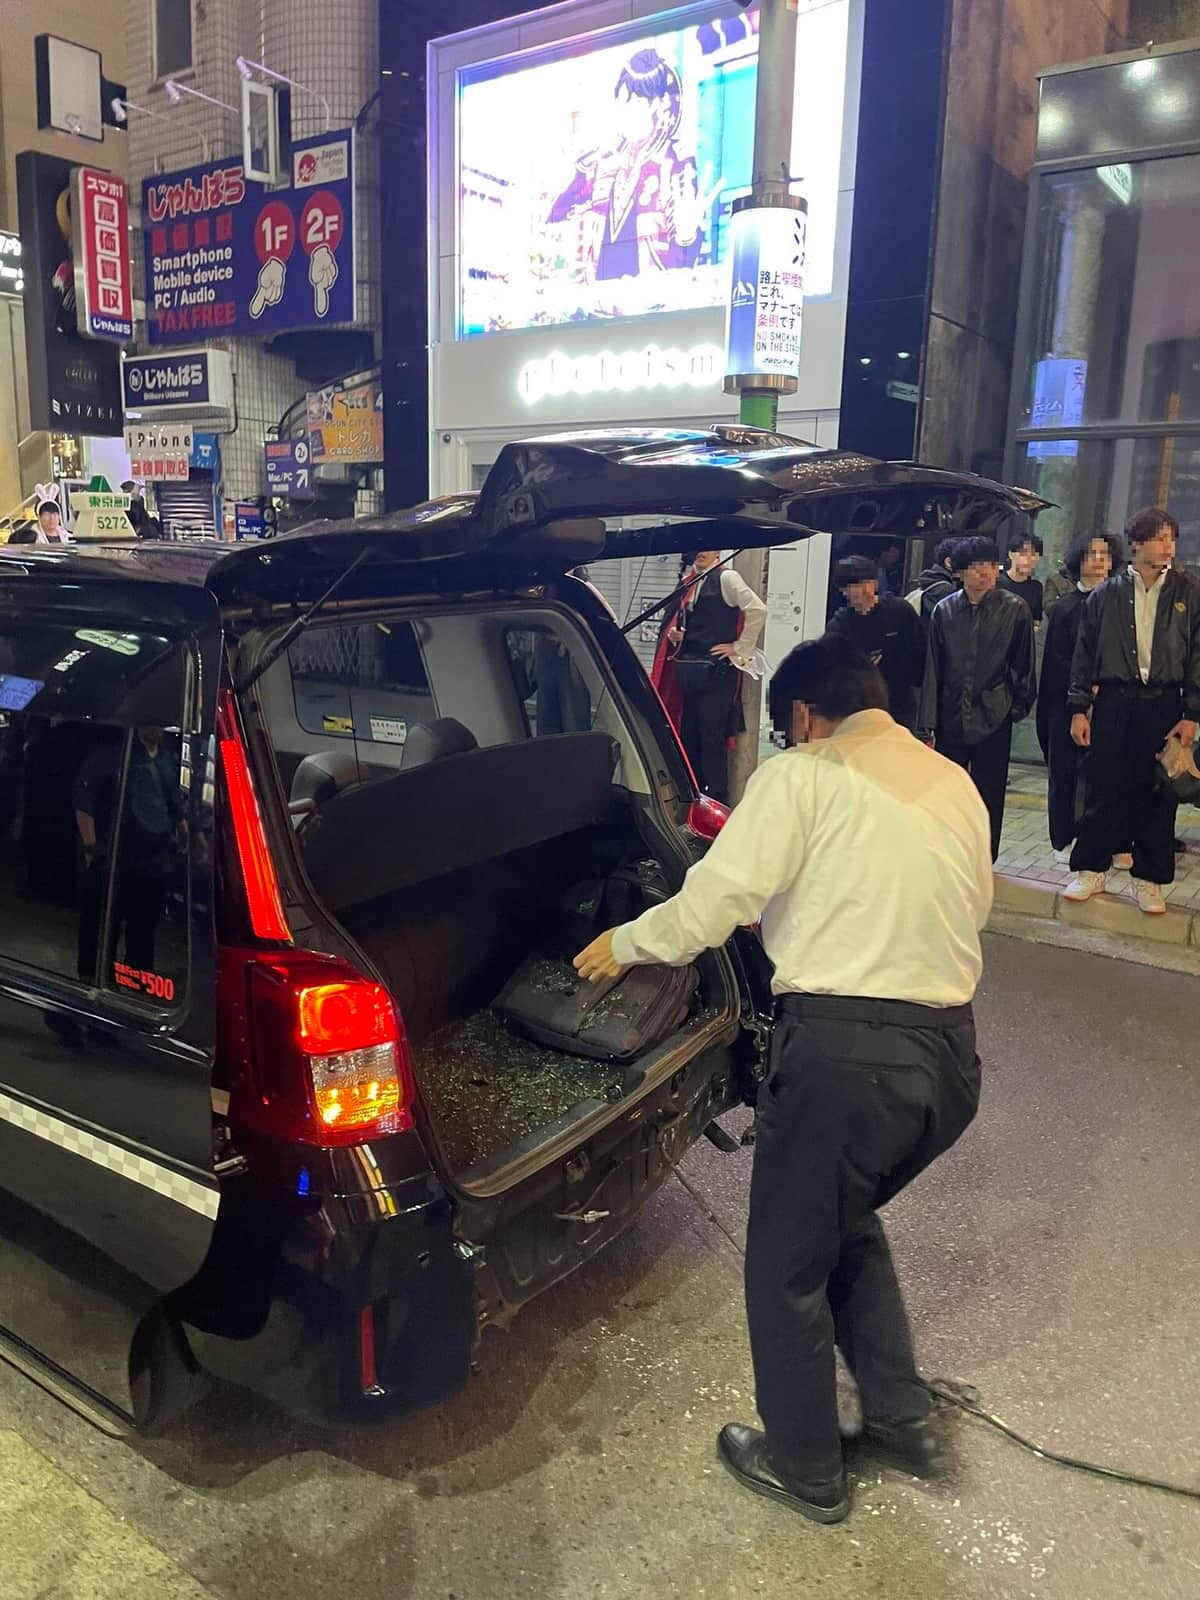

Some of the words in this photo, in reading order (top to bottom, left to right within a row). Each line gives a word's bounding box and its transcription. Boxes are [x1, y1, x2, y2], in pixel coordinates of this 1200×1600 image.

[262, 215, 289, 252] 1F
[305, 207, 339, 244] 2F
[153, 246, 233, 273] Smartphone
[154, 271, 192, 291] Mobile
[193, 265, 234, 284] device
[154, 292, 172, 310] PC
[180, 287, 216, 307] Audio
[155, 307, 190, 333] TAX
[191, 300, 237, 329] FREE
[755, 341, 767, 352] ON
[338, 430, 371, 443] トレカ
[97, 516, 129, 530] 5272
